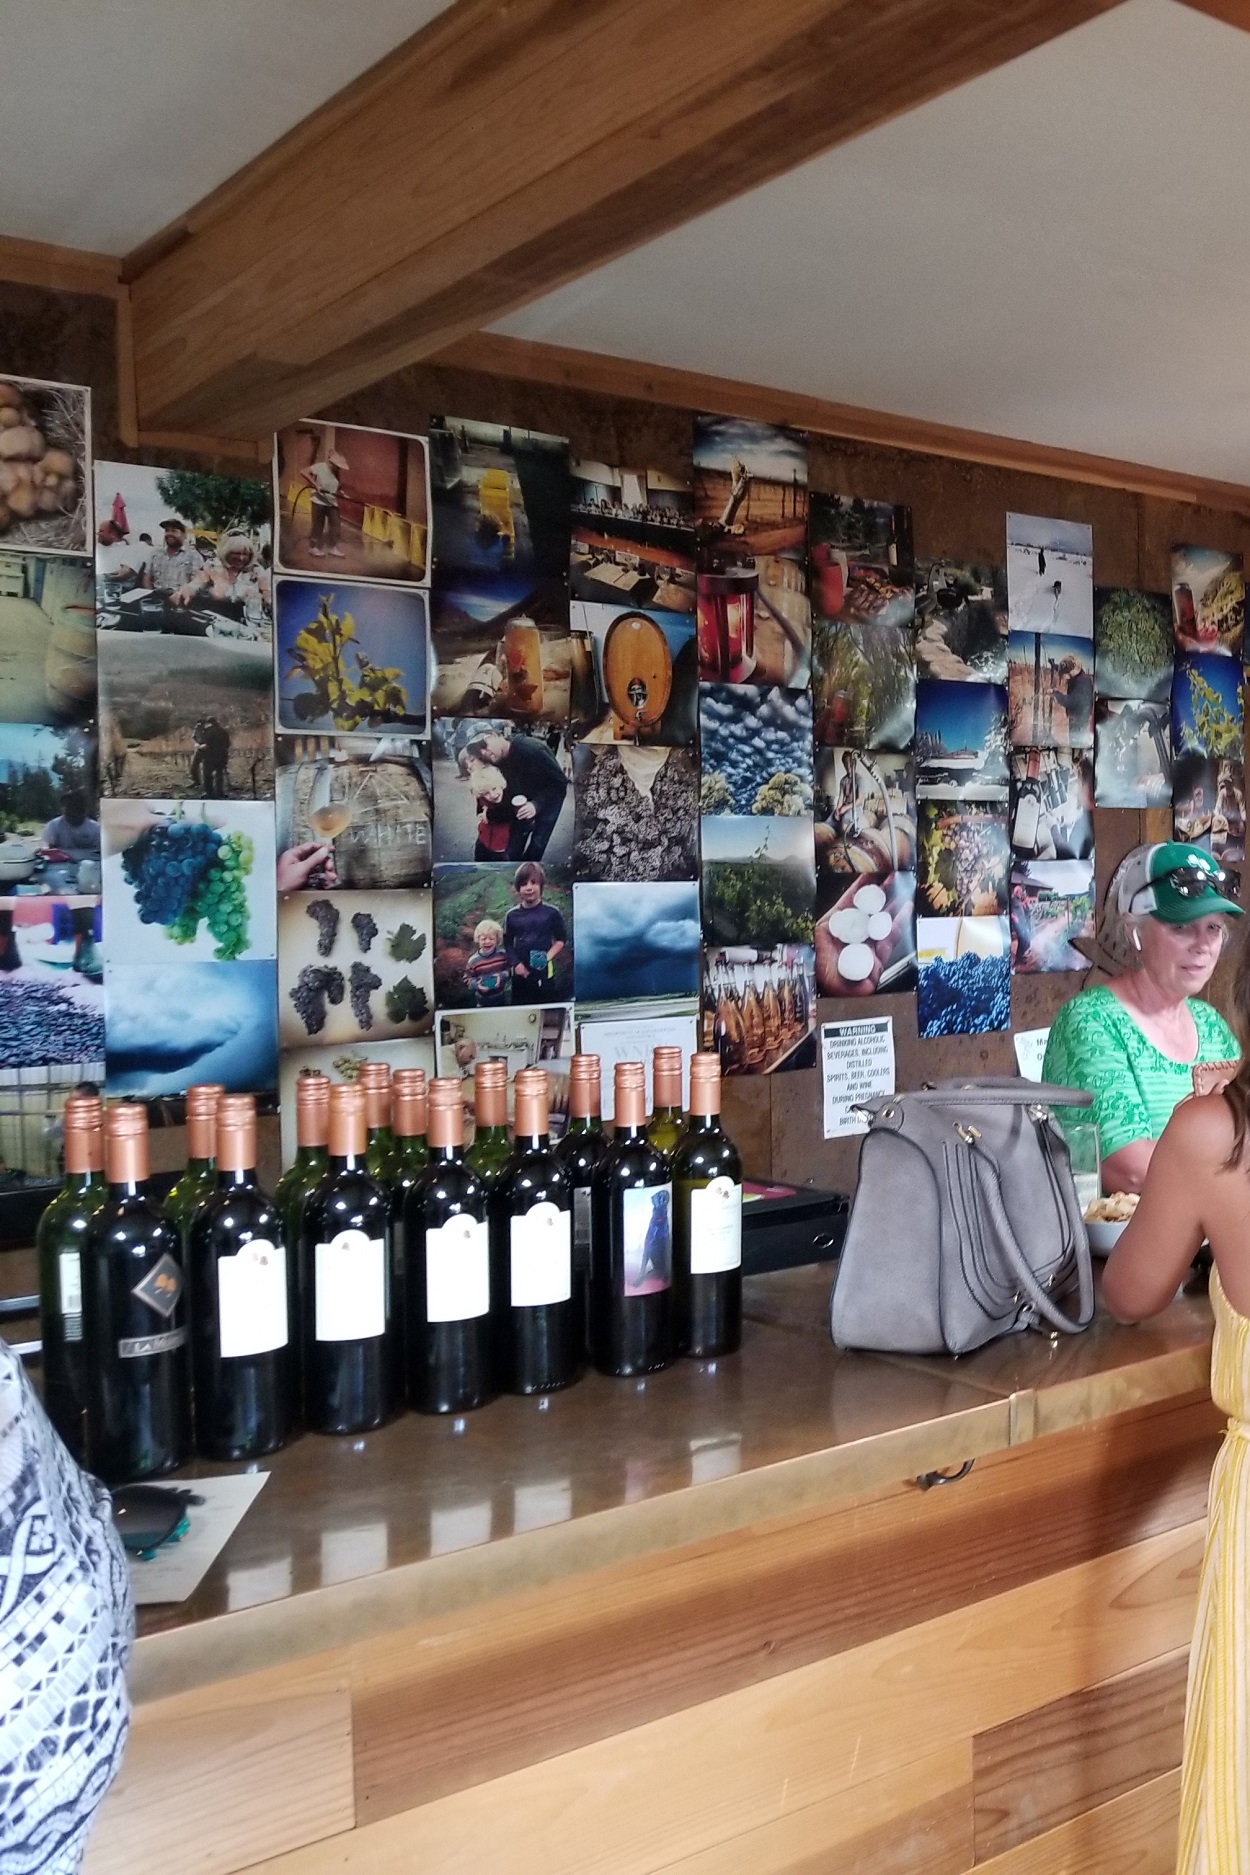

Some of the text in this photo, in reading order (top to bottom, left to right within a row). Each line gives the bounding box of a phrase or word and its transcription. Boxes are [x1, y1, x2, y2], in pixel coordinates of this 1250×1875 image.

[350, 823, 426, 847] WHITE
[839, 1024, 876, 1037] WARNING
[829, 1035, 885, 1049] DRINKING ALCOHOLIC
[846, 1059, 873, 1069] DISTILLED
[846, 1080, 872, 1092] AND WINE
[832, 1094, 854, 1105] DURING
